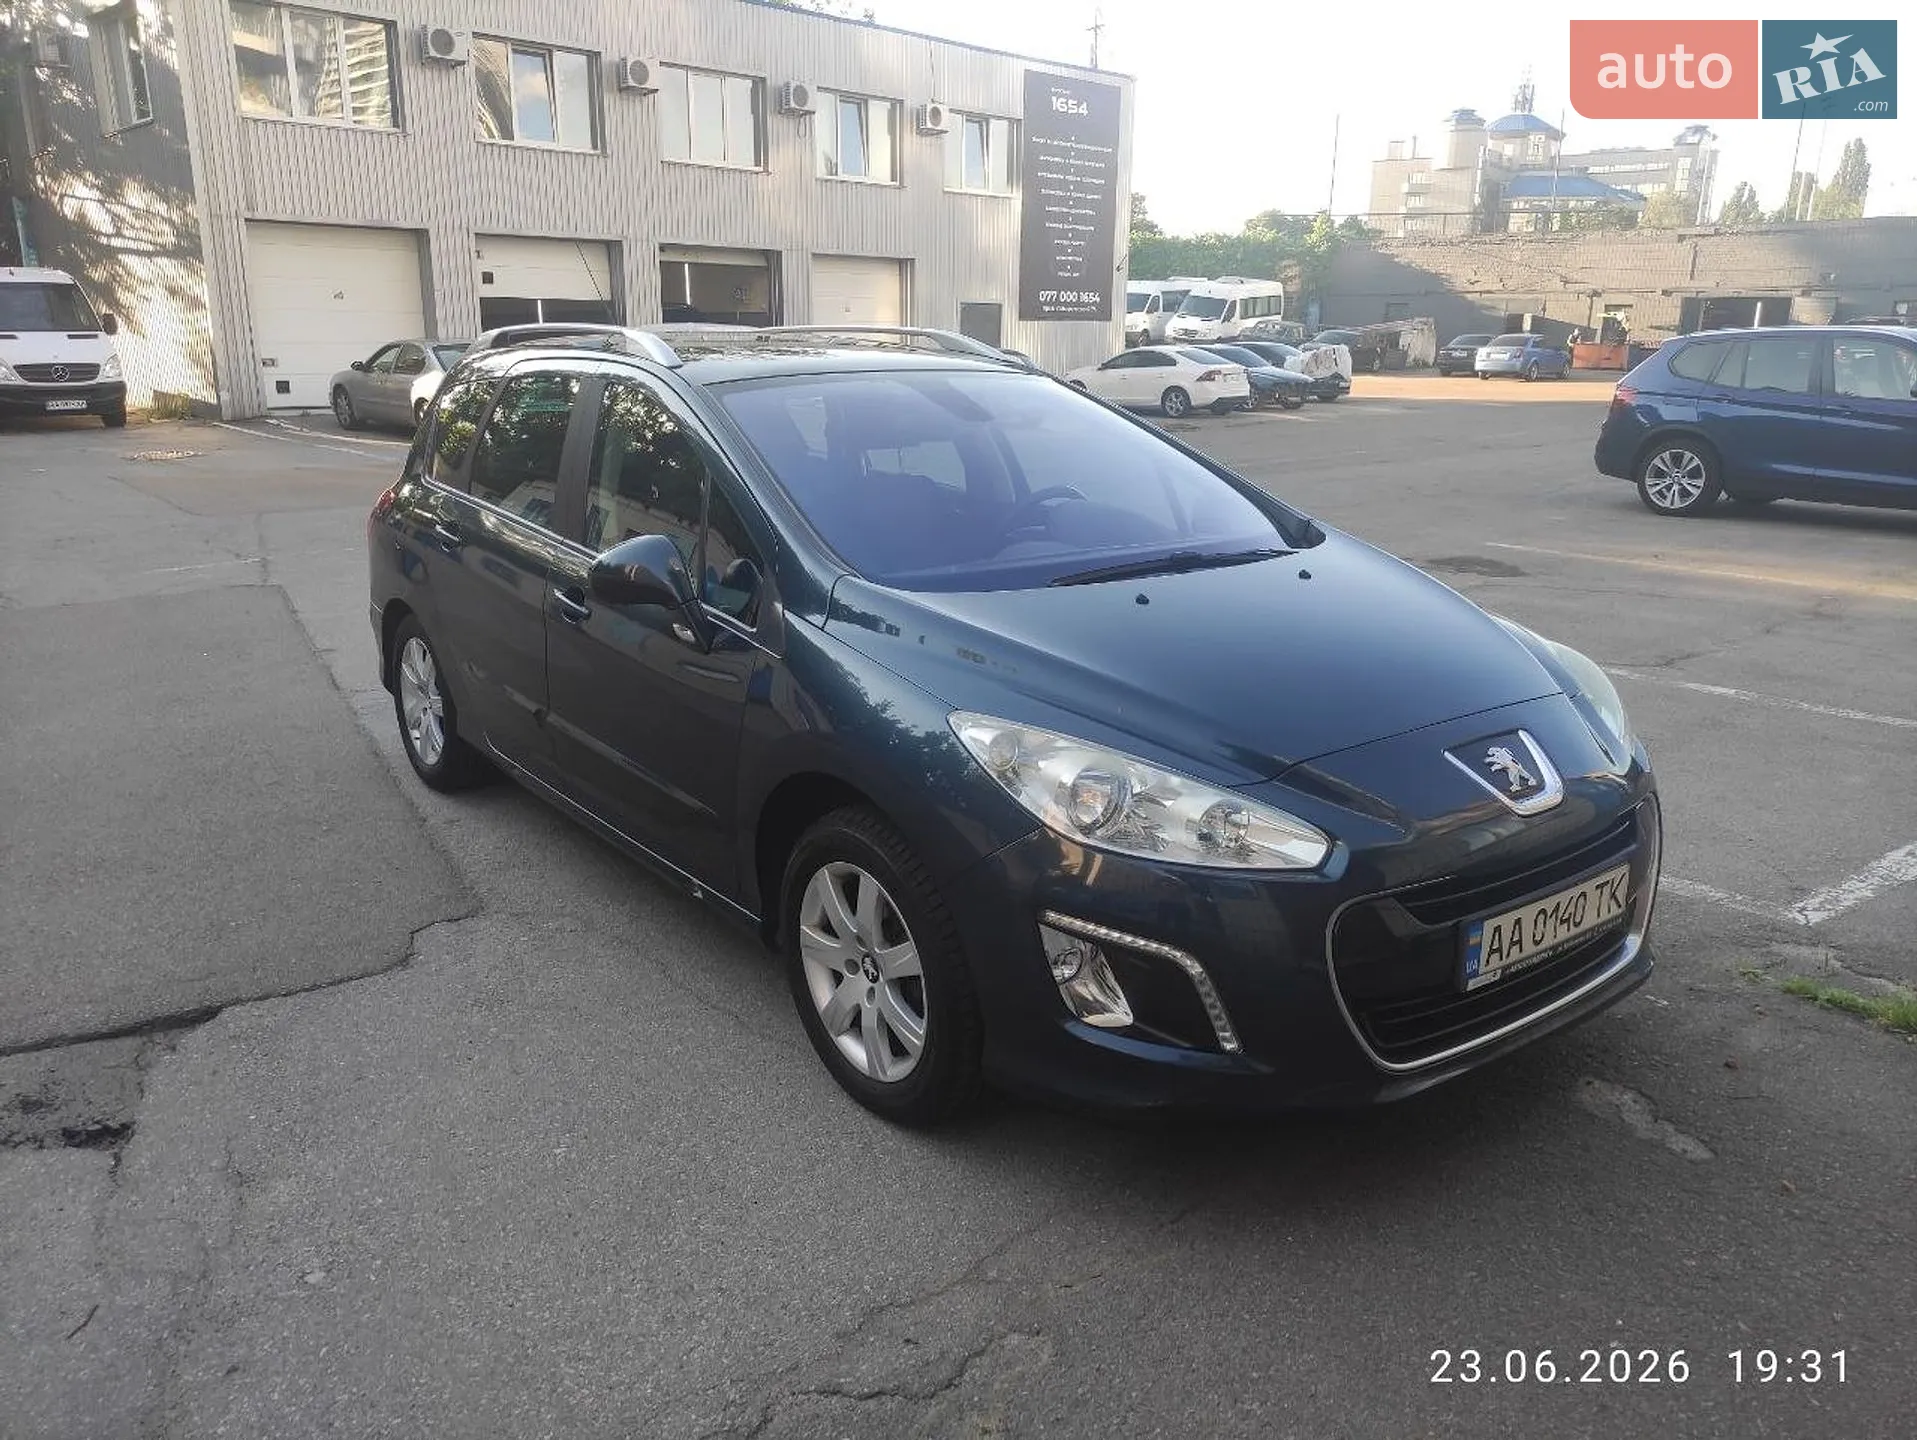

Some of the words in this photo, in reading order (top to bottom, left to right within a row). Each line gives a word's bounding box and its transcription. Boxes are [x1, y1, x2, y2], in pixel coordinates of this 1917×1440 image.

[1051, 96, 1088, 116] 1654
[1039, 290, 1058, 302] 077
[1060, 291, 1078, 303] 000
[1080, 292, 1101, 304] 1654
[1484, 917, 1524, 967] AA
[1532, 891, 1587, 946] 0140
[1595, 872, 1627, 918] TK
